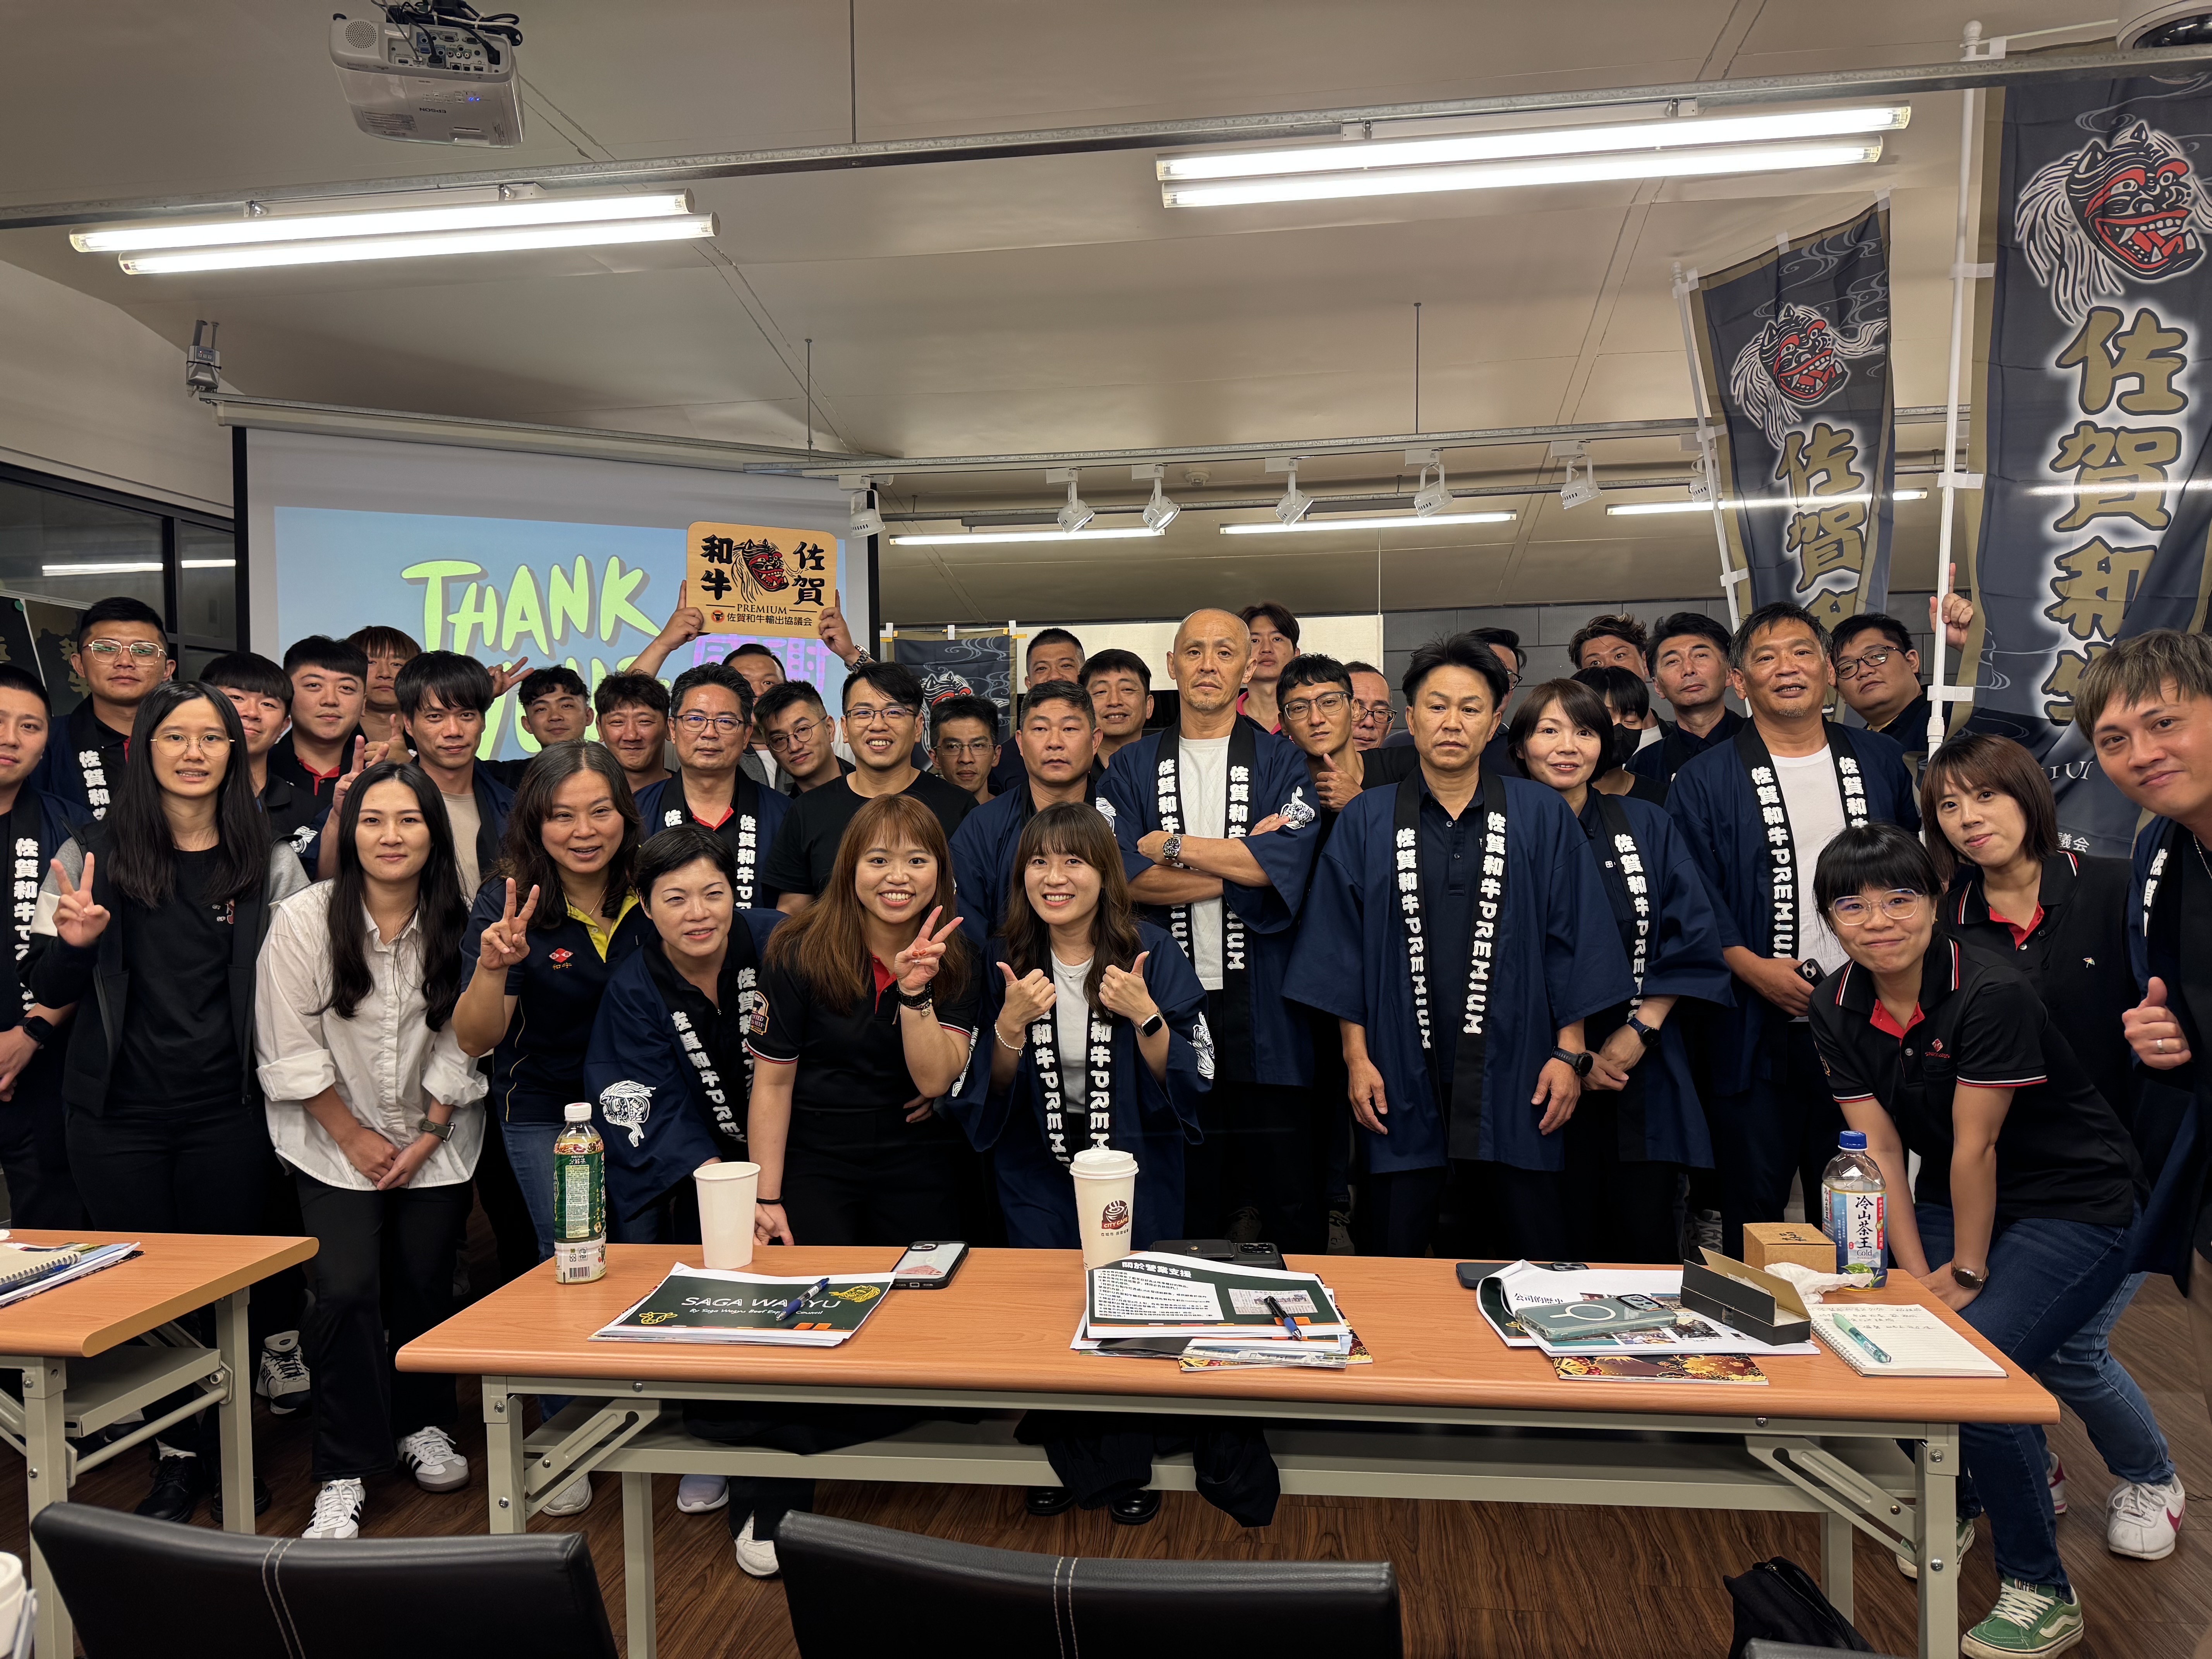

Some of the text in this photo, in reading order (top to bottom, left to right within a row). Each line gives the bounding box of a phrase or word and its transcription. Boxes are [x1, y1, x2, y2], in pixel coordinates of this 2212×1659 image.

[700, 534, 734, 601] 和牛
[791, 541, 825, 606] 佐賀
[400, 555, 663, 654] THANK
[726, 612, 812, 627] 佐賀和牛輸出協議会
[737, 603, 787, 615] PREMIUM
[1751, 766, 1794, 958] 佐賀和牛PREMIU
[2143, 848, 2168, 937] 佐賀
[1396, 827, 1432, 1049] 佐賀和牛PREMIUM
[1462, 811, 1506, 1035] 佐賀和牛PREMIUM
[1855, 1195, 1874, 1249] 冷山茶王
[1121, 1261, 1192, 1278] 關於營業支援
[681, 1297, 841, 1309] SAGA WAYU
